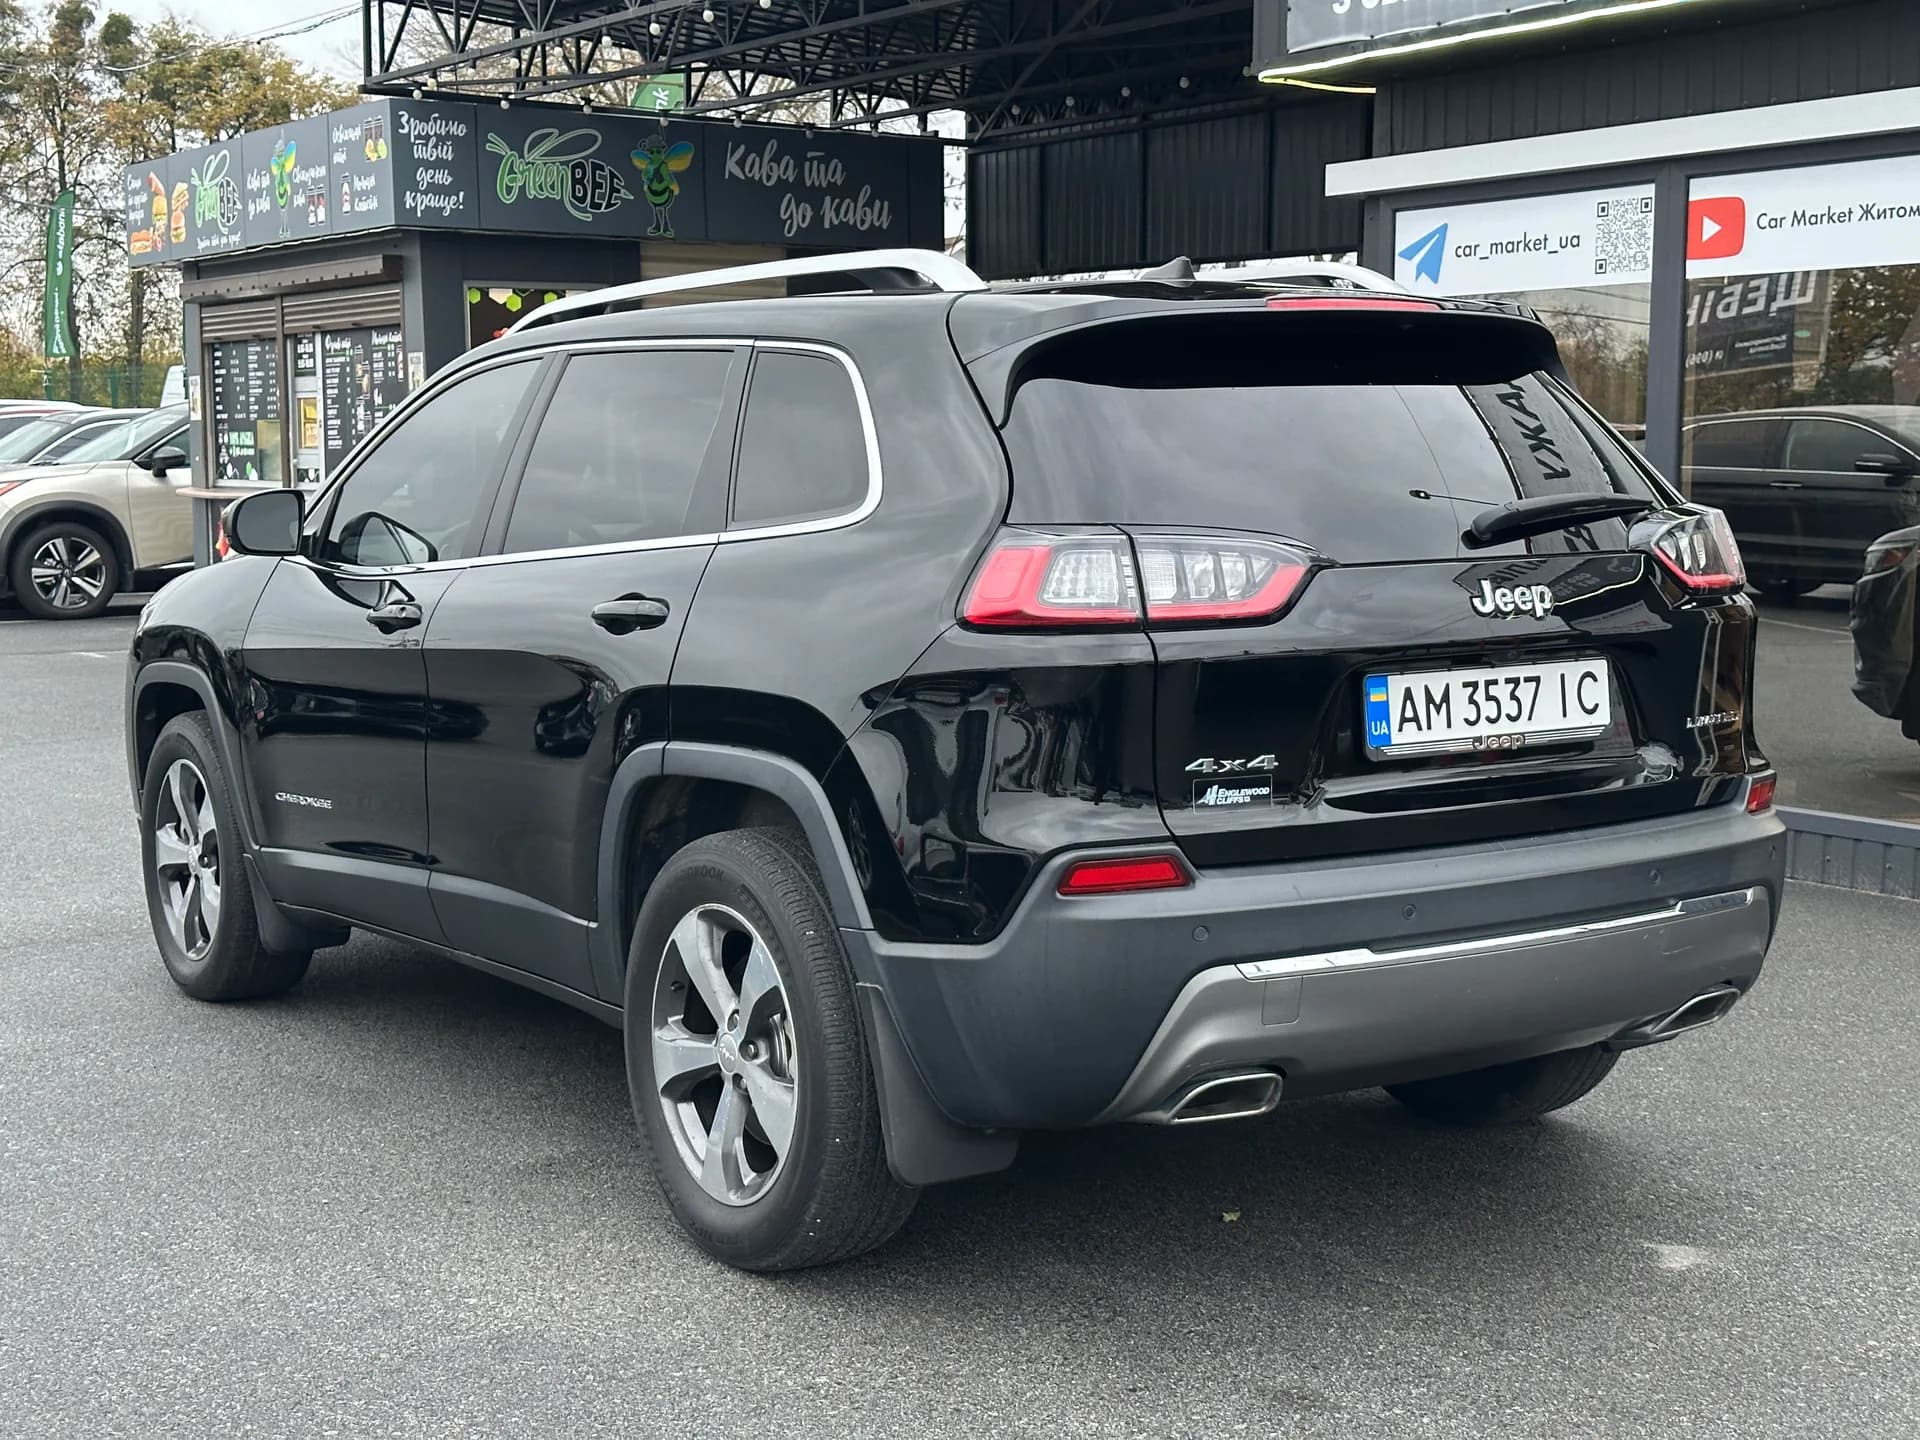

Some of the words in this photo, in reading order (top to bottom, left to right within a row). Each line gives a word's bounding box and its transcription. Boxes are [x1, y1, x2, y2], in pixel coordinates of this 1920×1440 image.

[398, 110, 467, 143] Зробимо
[413, 136, 454, 161] твій
[725, 139, 797, 186] Кава
[804, 151, 847, 188] та
[416, 166, 453, 191] день
[404, 190, 465, 218] краще!
[780, 193, 814, 237] до
[820, 184, 892, 231] кави
[1756, 212, 1787, 230] Car
[1790, 205, 1853, 228] Market
[1455, 231, 1580, 260] car_market_ua
[1471, 578, 1554, 619] Jeep
[1398, 683, 1452, 732] AM
[1462, 675, 1541, 726] 3537
[1559, 670, 1600, 719] IC
[1371, 719, 1389, 736] UA
[1474, 734, 1525, 751] Jeep
[1185, 754, 1279, 773] 4x4
[274, 792, 333, 810] CHEROKEE
[1216, 796, 1244, 805] CLIFFS
[1217, 786, 1270, 798] ENGLEWOOD
